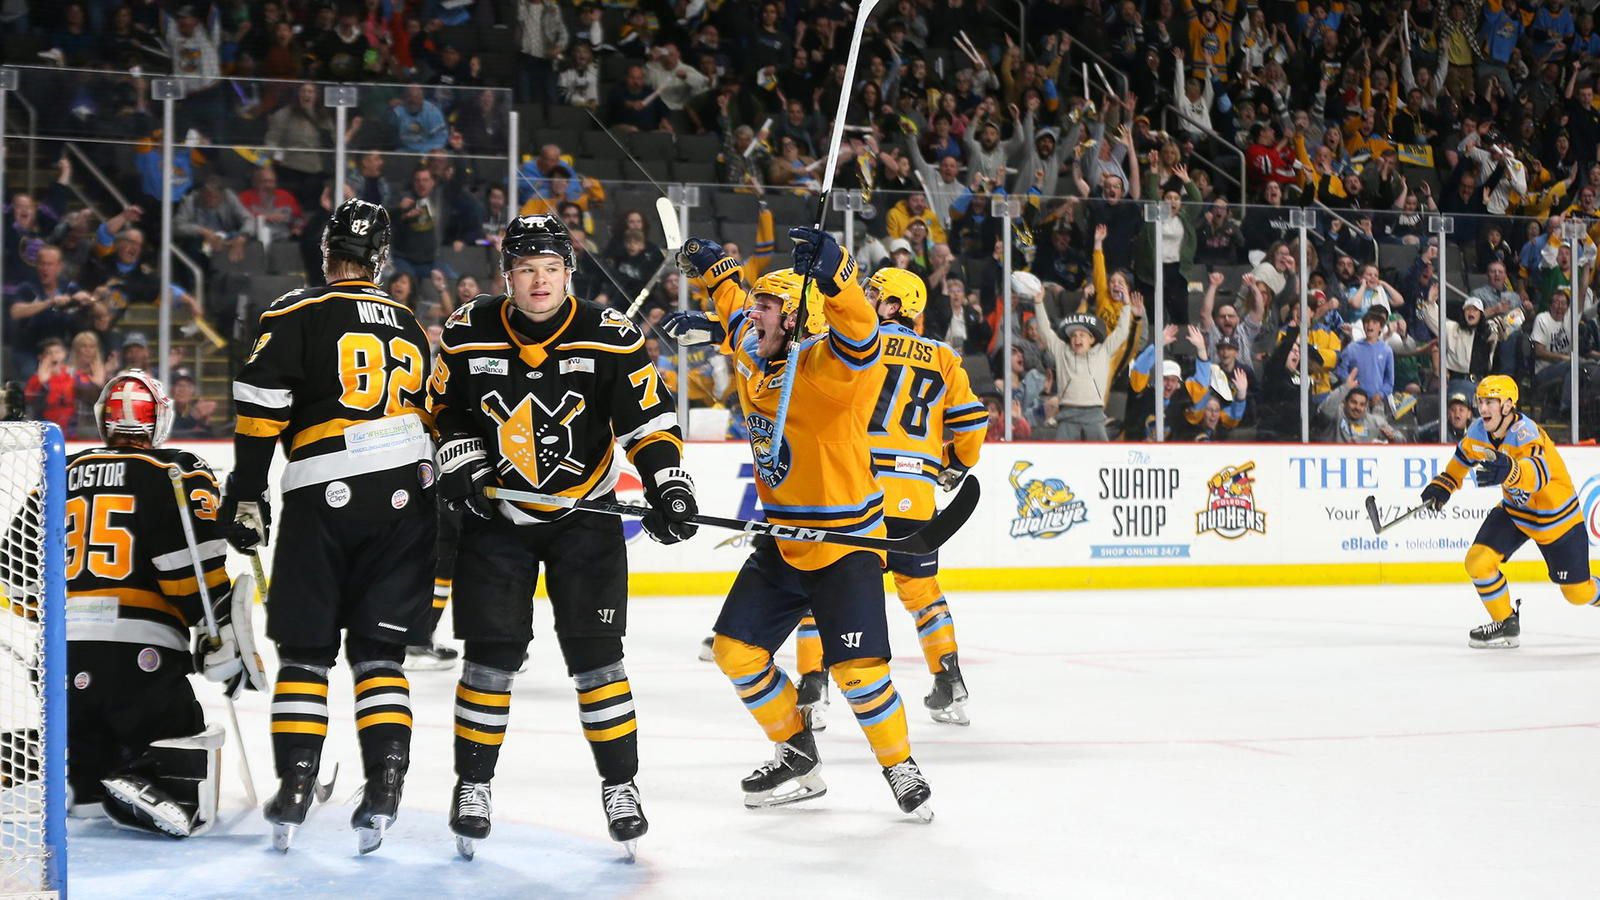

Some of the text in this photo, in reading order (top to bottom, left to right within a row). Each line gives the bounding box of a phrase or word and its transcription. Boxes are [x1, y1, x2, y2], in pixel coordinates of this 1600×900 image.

[351, 219, 370, 236] 82
[356, 300, 404, 330] NICKL
[884, 337, 934, 364] BLISS
[336, 331, 424, 417] 82
[867, 363, 946, 438] 18
[1127, 450, 1151, 465] The
[67, 462, 126, 491] CASTOR
[1099, 467, 1180, 500] SWAMP
[1289, 456, 1380, 489] THE
[327, 488, 347, 497] Great
[329, 494, 347, 503] Clips
[1216, 499, 1246, 507] TOLEDO
[1113, 505, 1167, 537] SHOP
[1197, 507, 1265, 533] MUDHENS
[1325, 506, 1360, 521] Your
[65, 493, 135, 580] 35
[744, 519, 827, 542] CCM
[1101, 546, 1181, 557] SHOP ONLINE 24/7
[1341, 537, 1470, 551] eBlade toledoBlade
